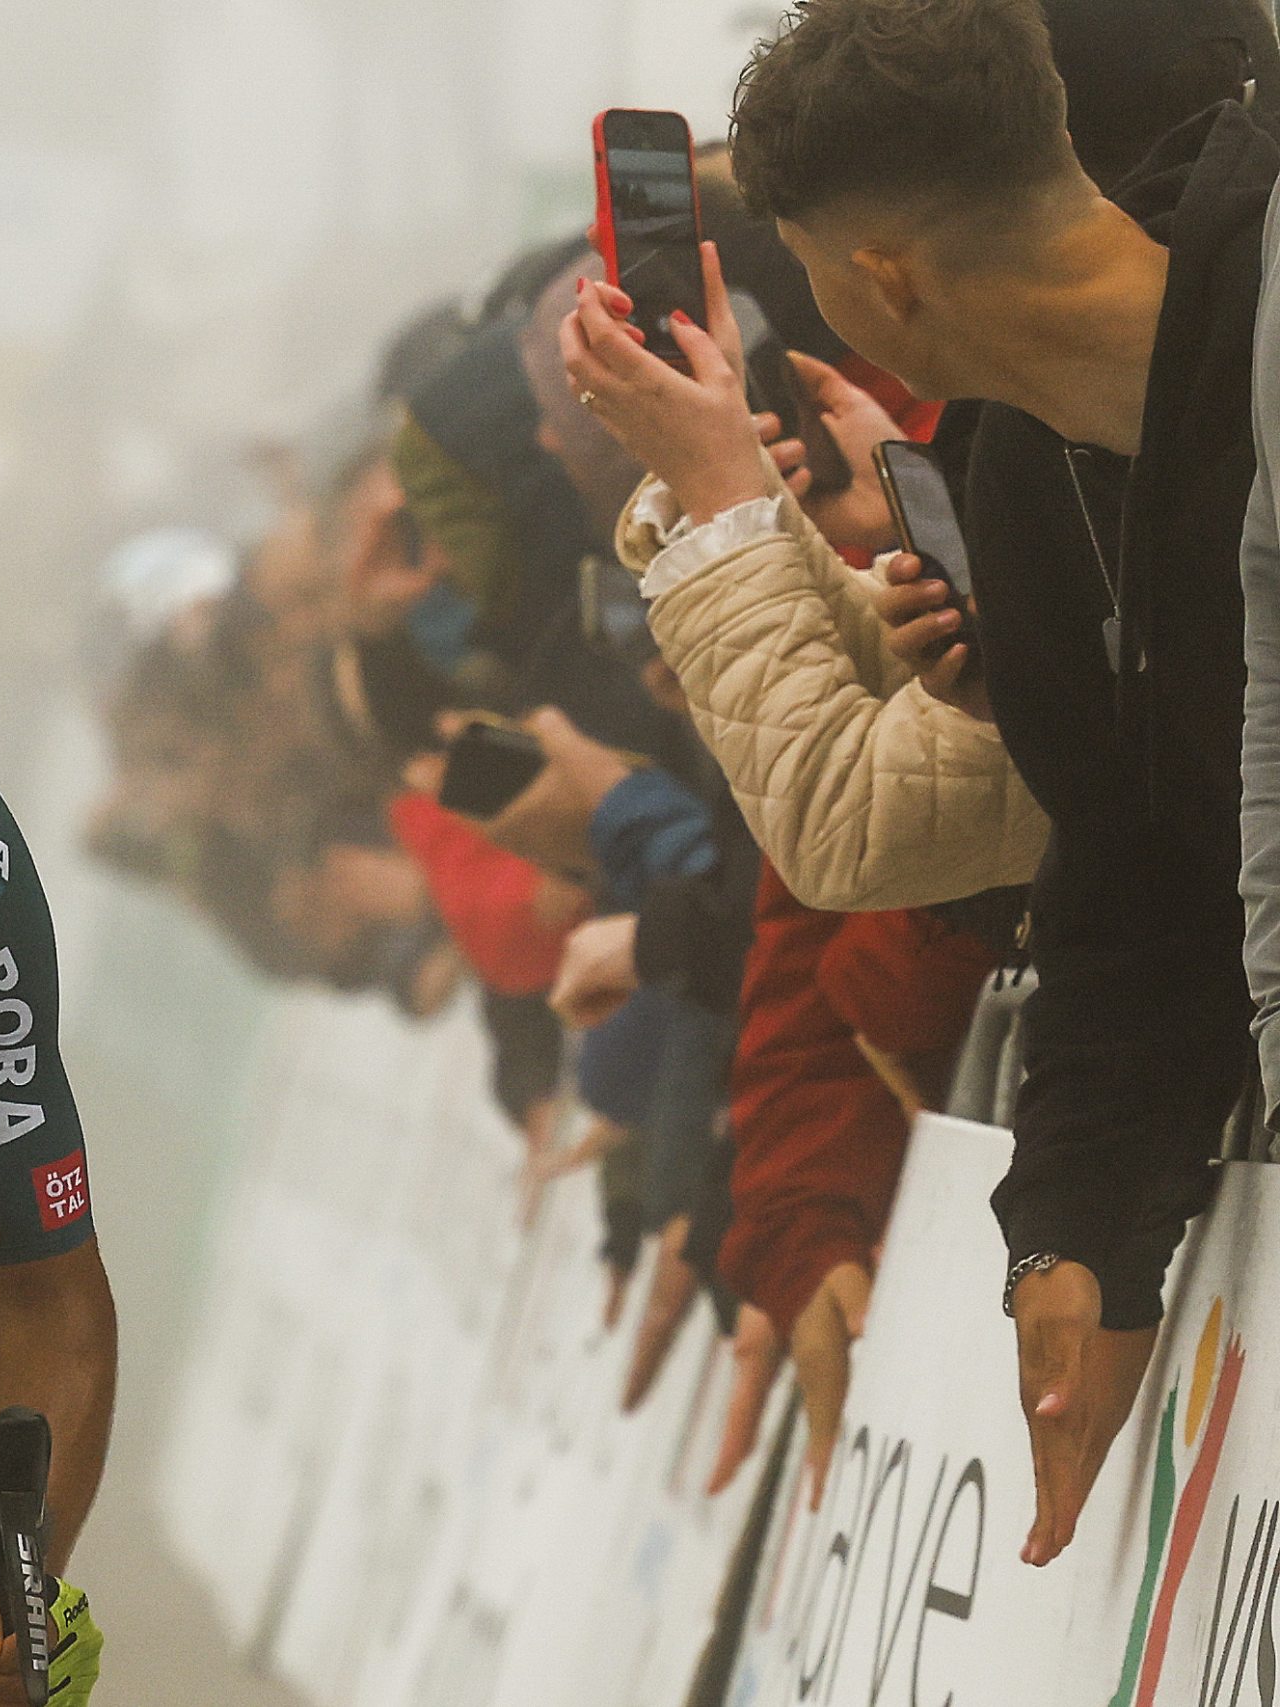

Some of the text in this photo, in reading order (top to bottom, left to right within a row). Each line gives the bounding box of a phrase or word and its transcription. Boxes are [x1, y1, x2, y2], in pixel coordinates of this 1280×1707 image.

[46, 1166, 83, 1198] ÖTZ
[49, 1191, 85, 1218] TAL
[17, 1533, 48, 1671] SRAM
